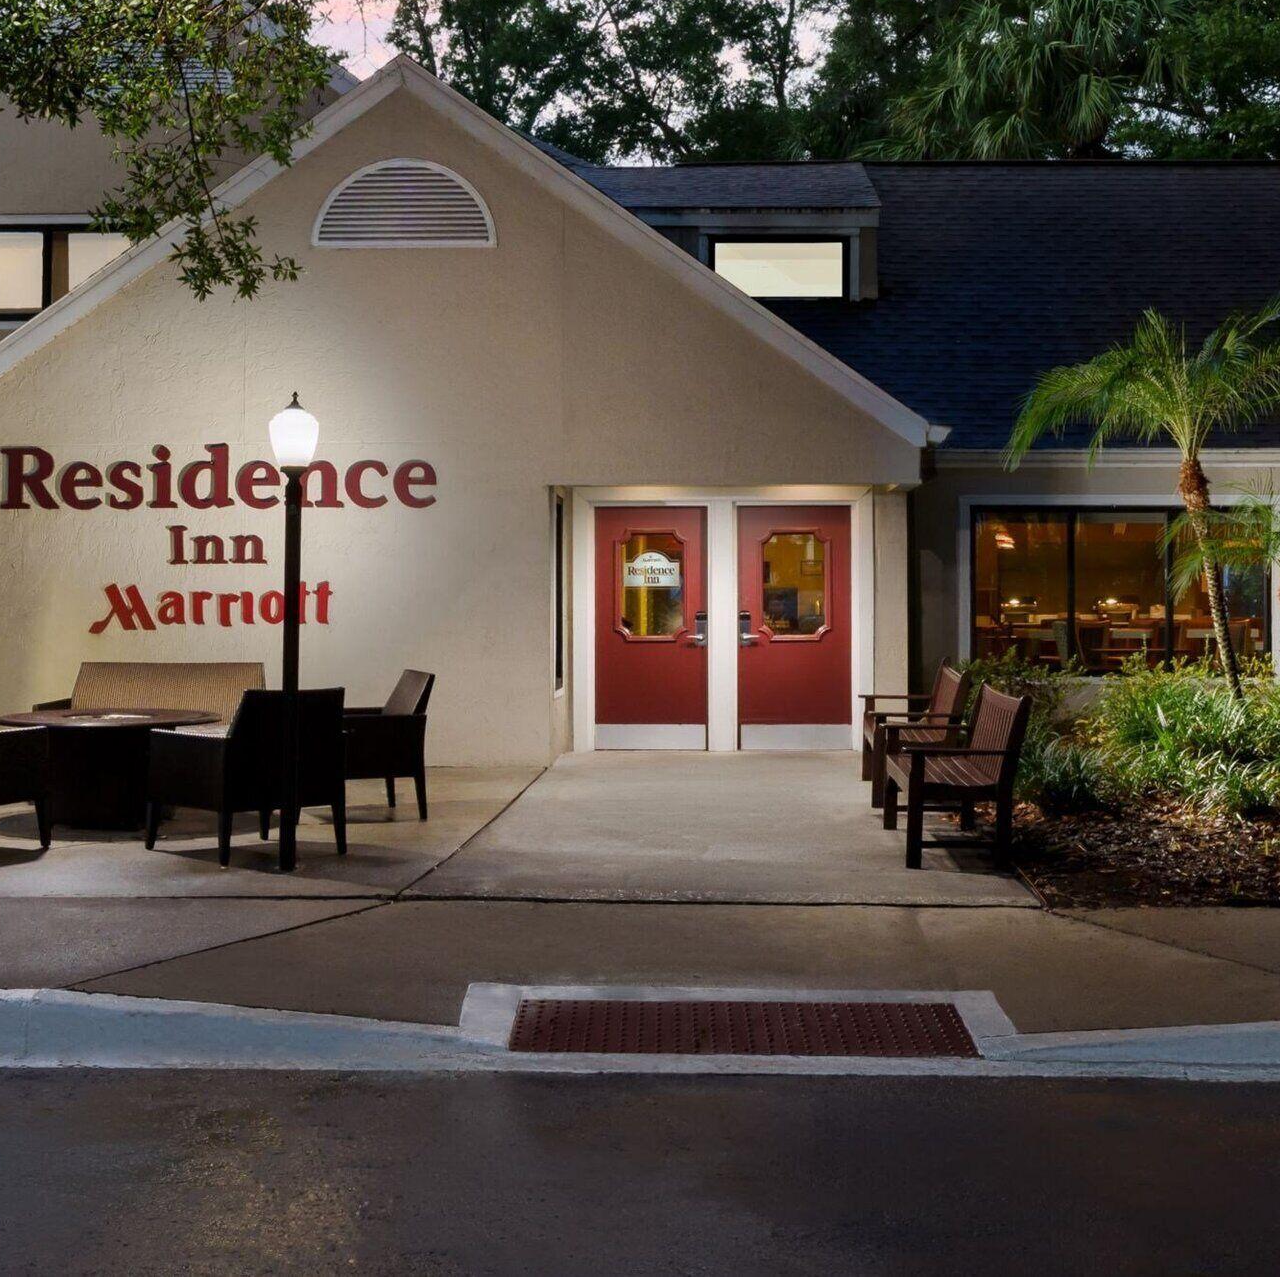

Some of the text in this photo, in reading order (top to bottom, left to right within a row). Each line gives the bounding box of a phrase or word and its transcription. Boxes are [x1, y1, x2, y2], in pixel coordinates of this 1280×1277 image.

[167, 525, 268, 565] Inn
[627, 565, 675, 576] Residence
[88, 581, 333, 635] Marriott
